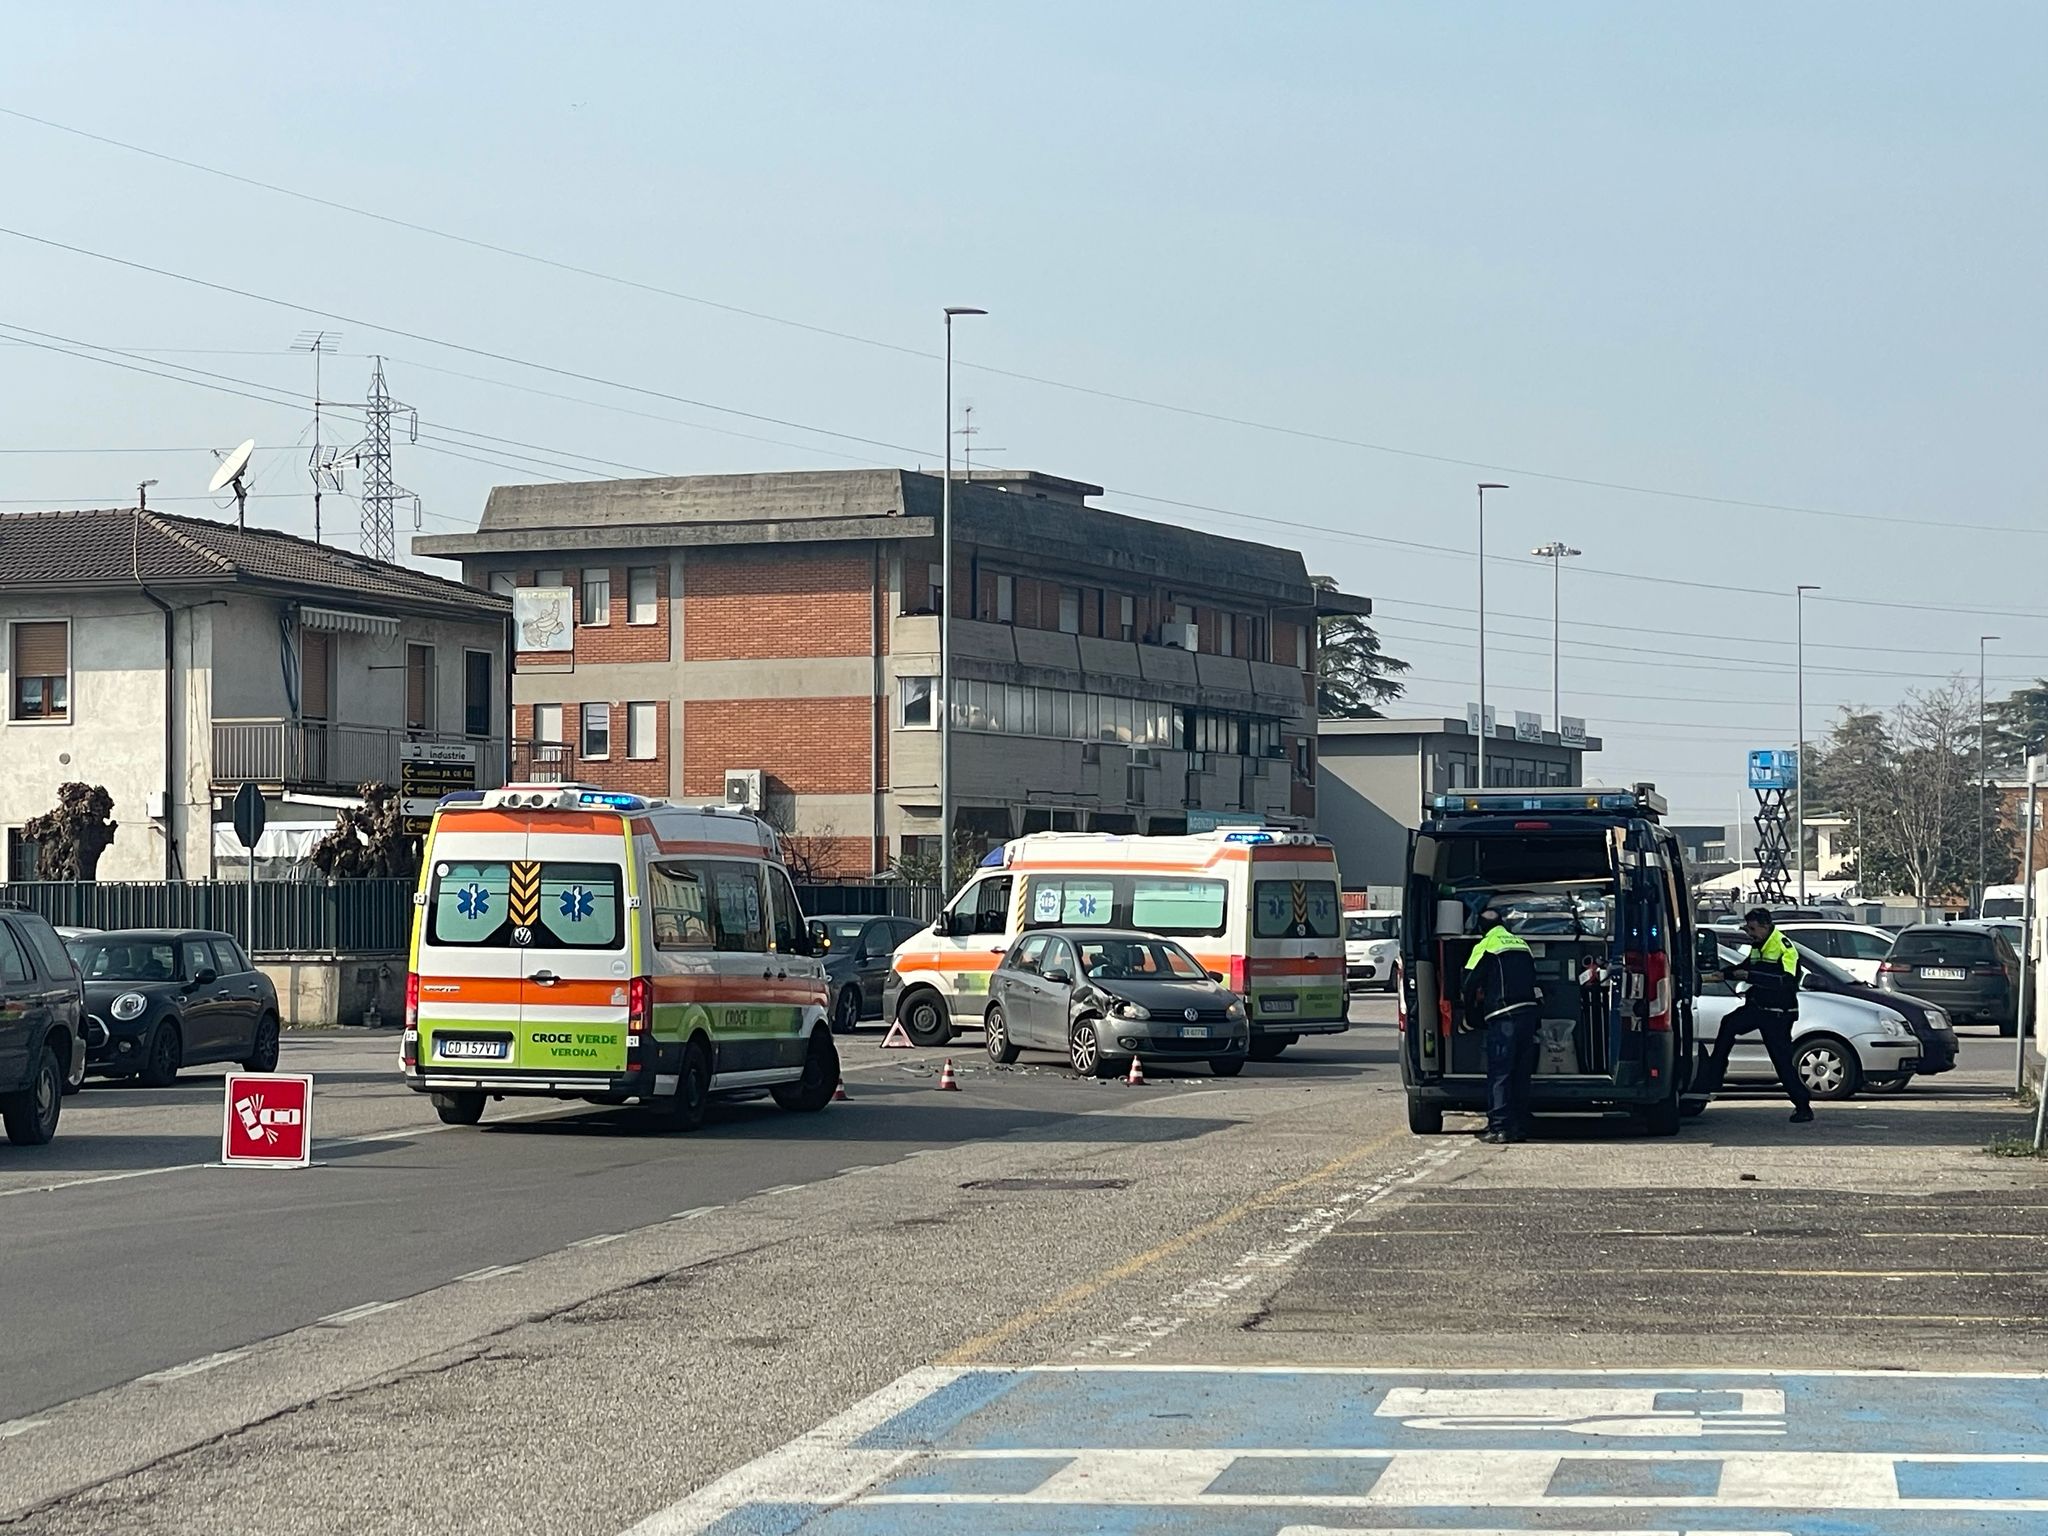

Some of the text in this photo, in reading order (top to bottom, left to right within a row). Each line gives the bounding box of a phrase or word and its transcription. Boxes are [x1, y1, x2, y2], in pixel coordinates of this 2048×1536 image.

[725, 1010, 748, 1025] CROCE
[532, 1033, 618, 1044] CROCE VERDE
[551, 1048, 598, 1057] VERONA
